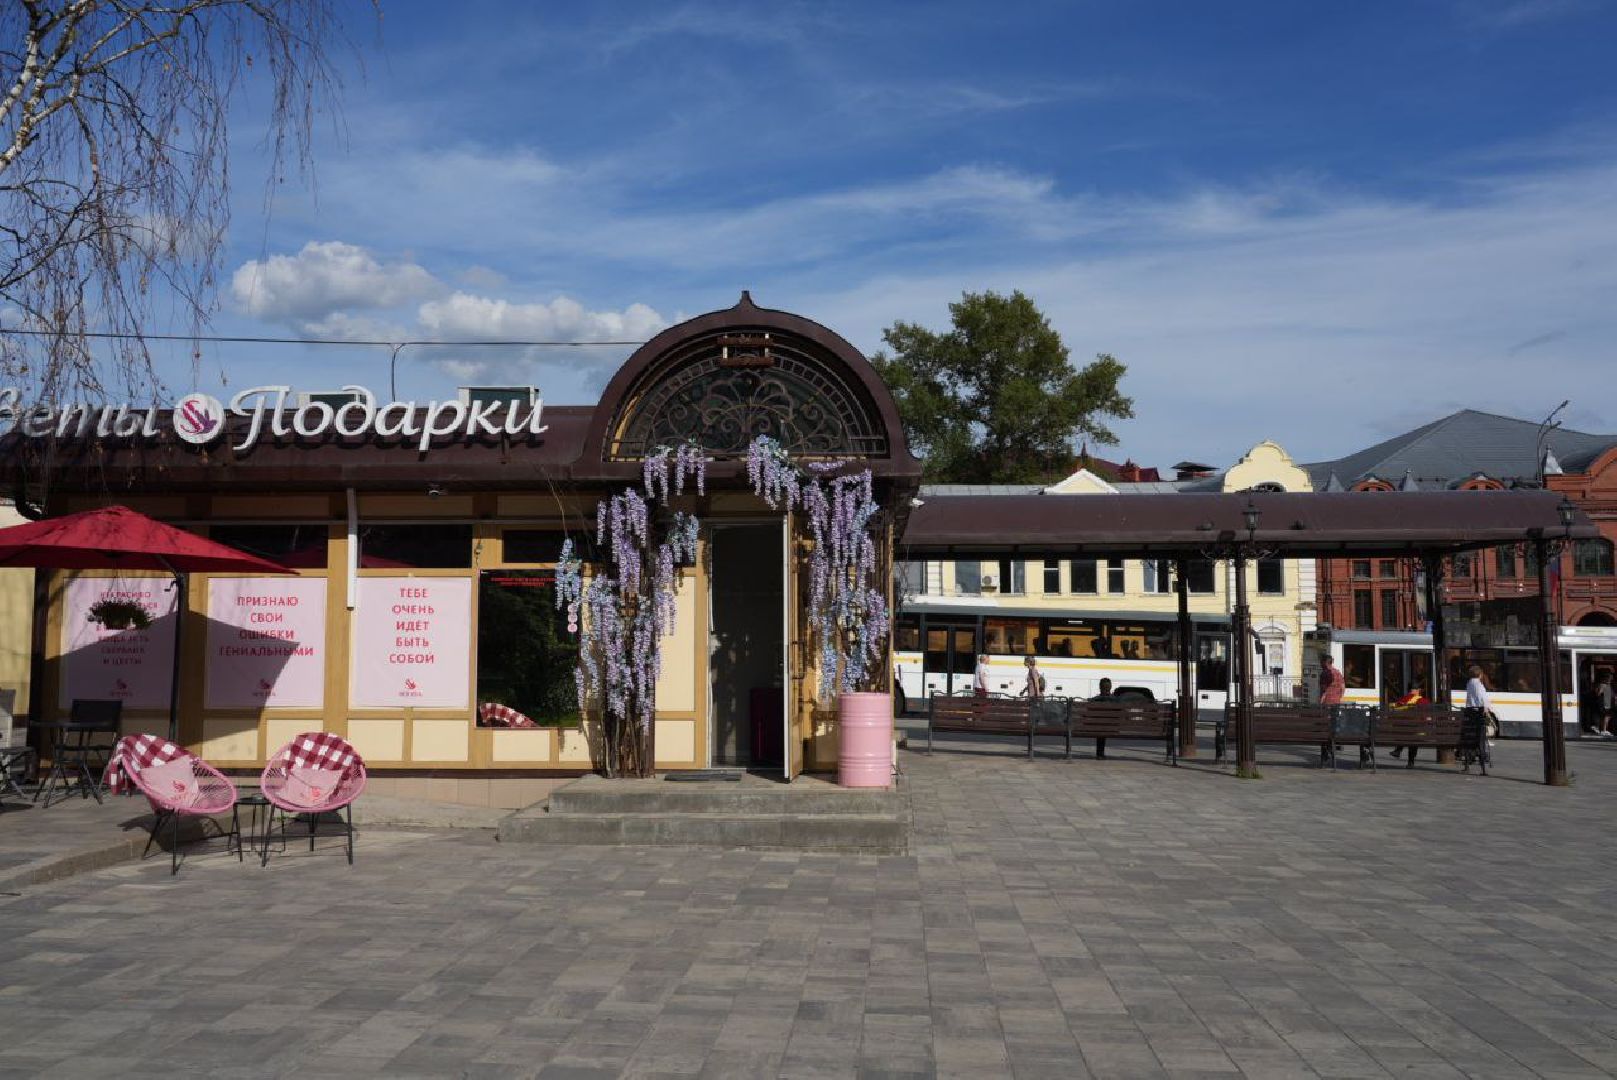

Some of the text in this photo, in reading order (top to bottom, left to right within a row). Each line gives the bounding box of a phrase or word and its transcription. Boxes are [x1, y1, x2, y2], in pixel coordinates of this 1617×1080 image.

[231, 385, 548, 451] Подарки
[400, 588, 428, 598] ТЕБЕ
[237, 596, 299, 607] ПРИЗНАЮ
[392, 605, 434, 614] ОЧЕНЬ
[250, 612, 283, 623] СВОИ
[240, 630, 294, 640] ОШИБКИ
[396, 637, 429, 647] БЫТЬ
[220, 647, 314, 657] ГЕНИАЛЬНЫМИ
[389, 652, 434, 664] СОБОЙ
